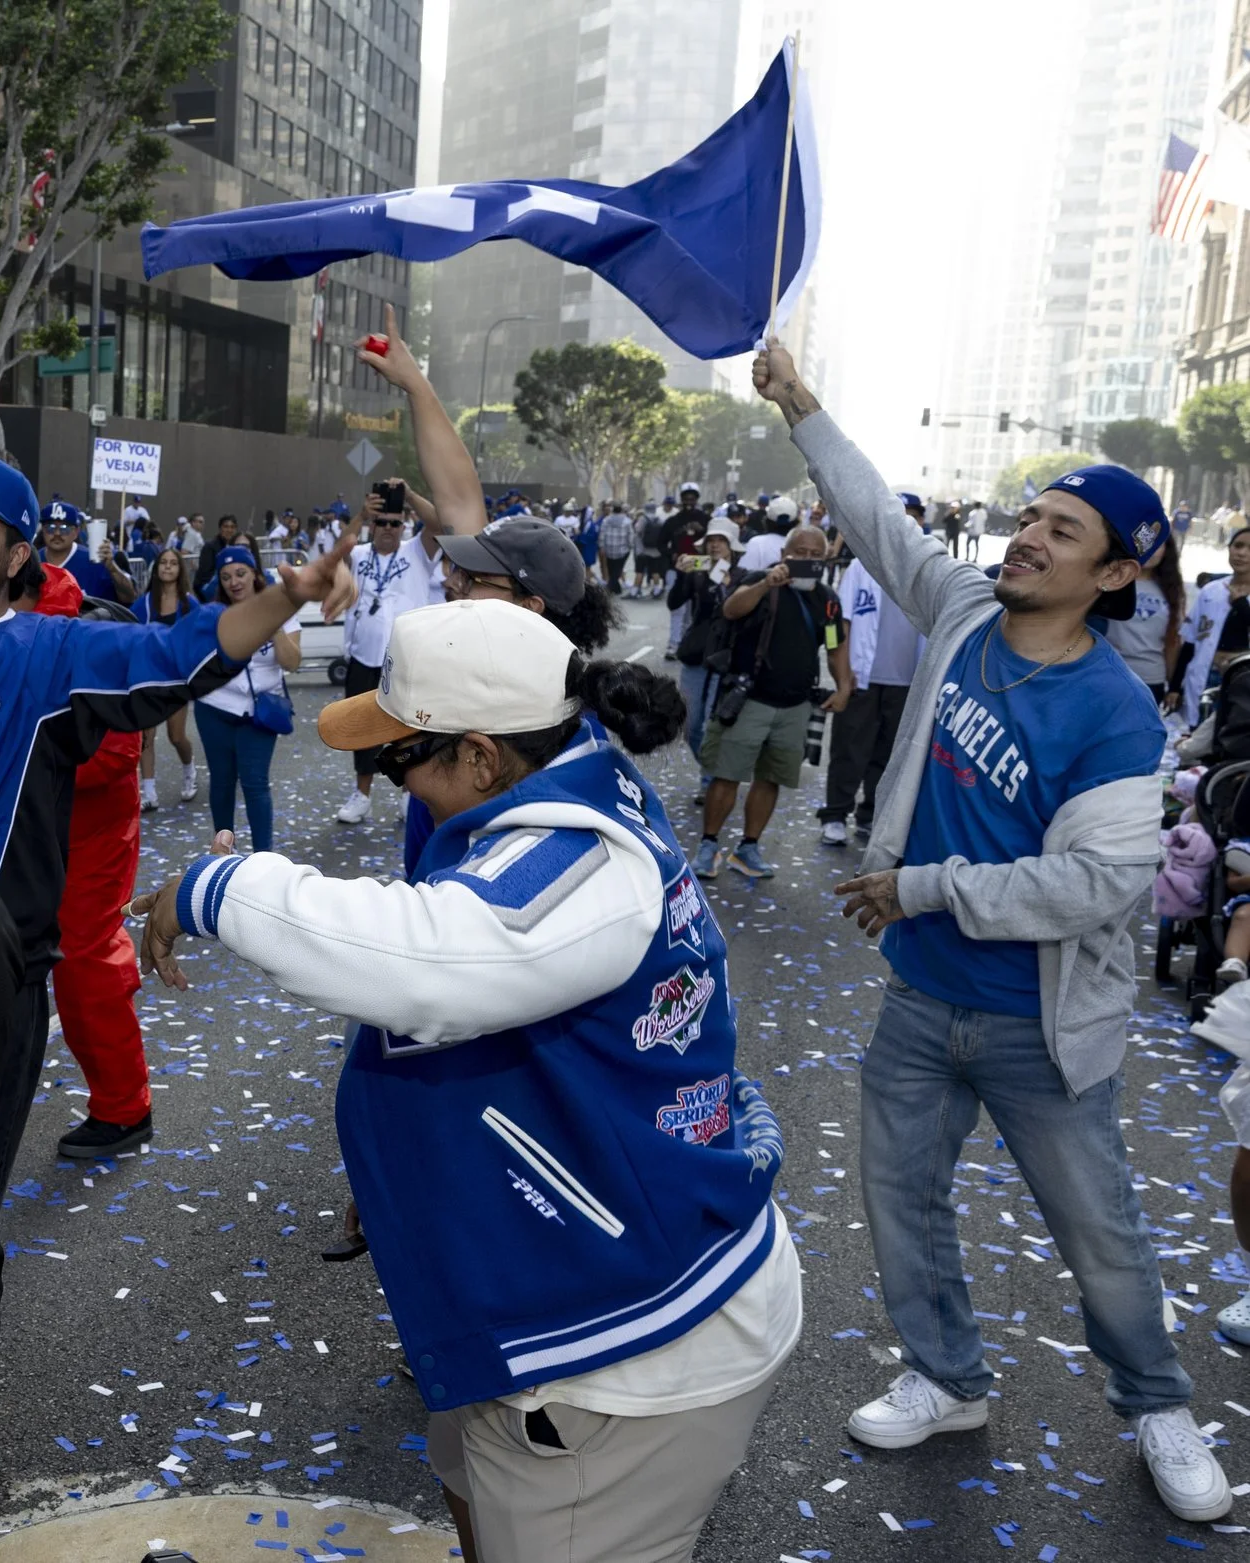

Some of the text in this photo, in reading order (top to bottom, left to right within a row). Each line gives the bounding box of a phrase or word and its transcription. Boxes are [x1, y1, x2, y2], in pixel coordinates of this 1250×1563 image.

[95, 439, 158, 459] FOR YOU,
[106, 458, 145, 473] VESIA
[50, 502, 67, 520] LA
[939, 689, 1029, 803] ANGELES
[634, 1003, 683, 1048] World
[660, 1102, 718, 1130] SERIES
